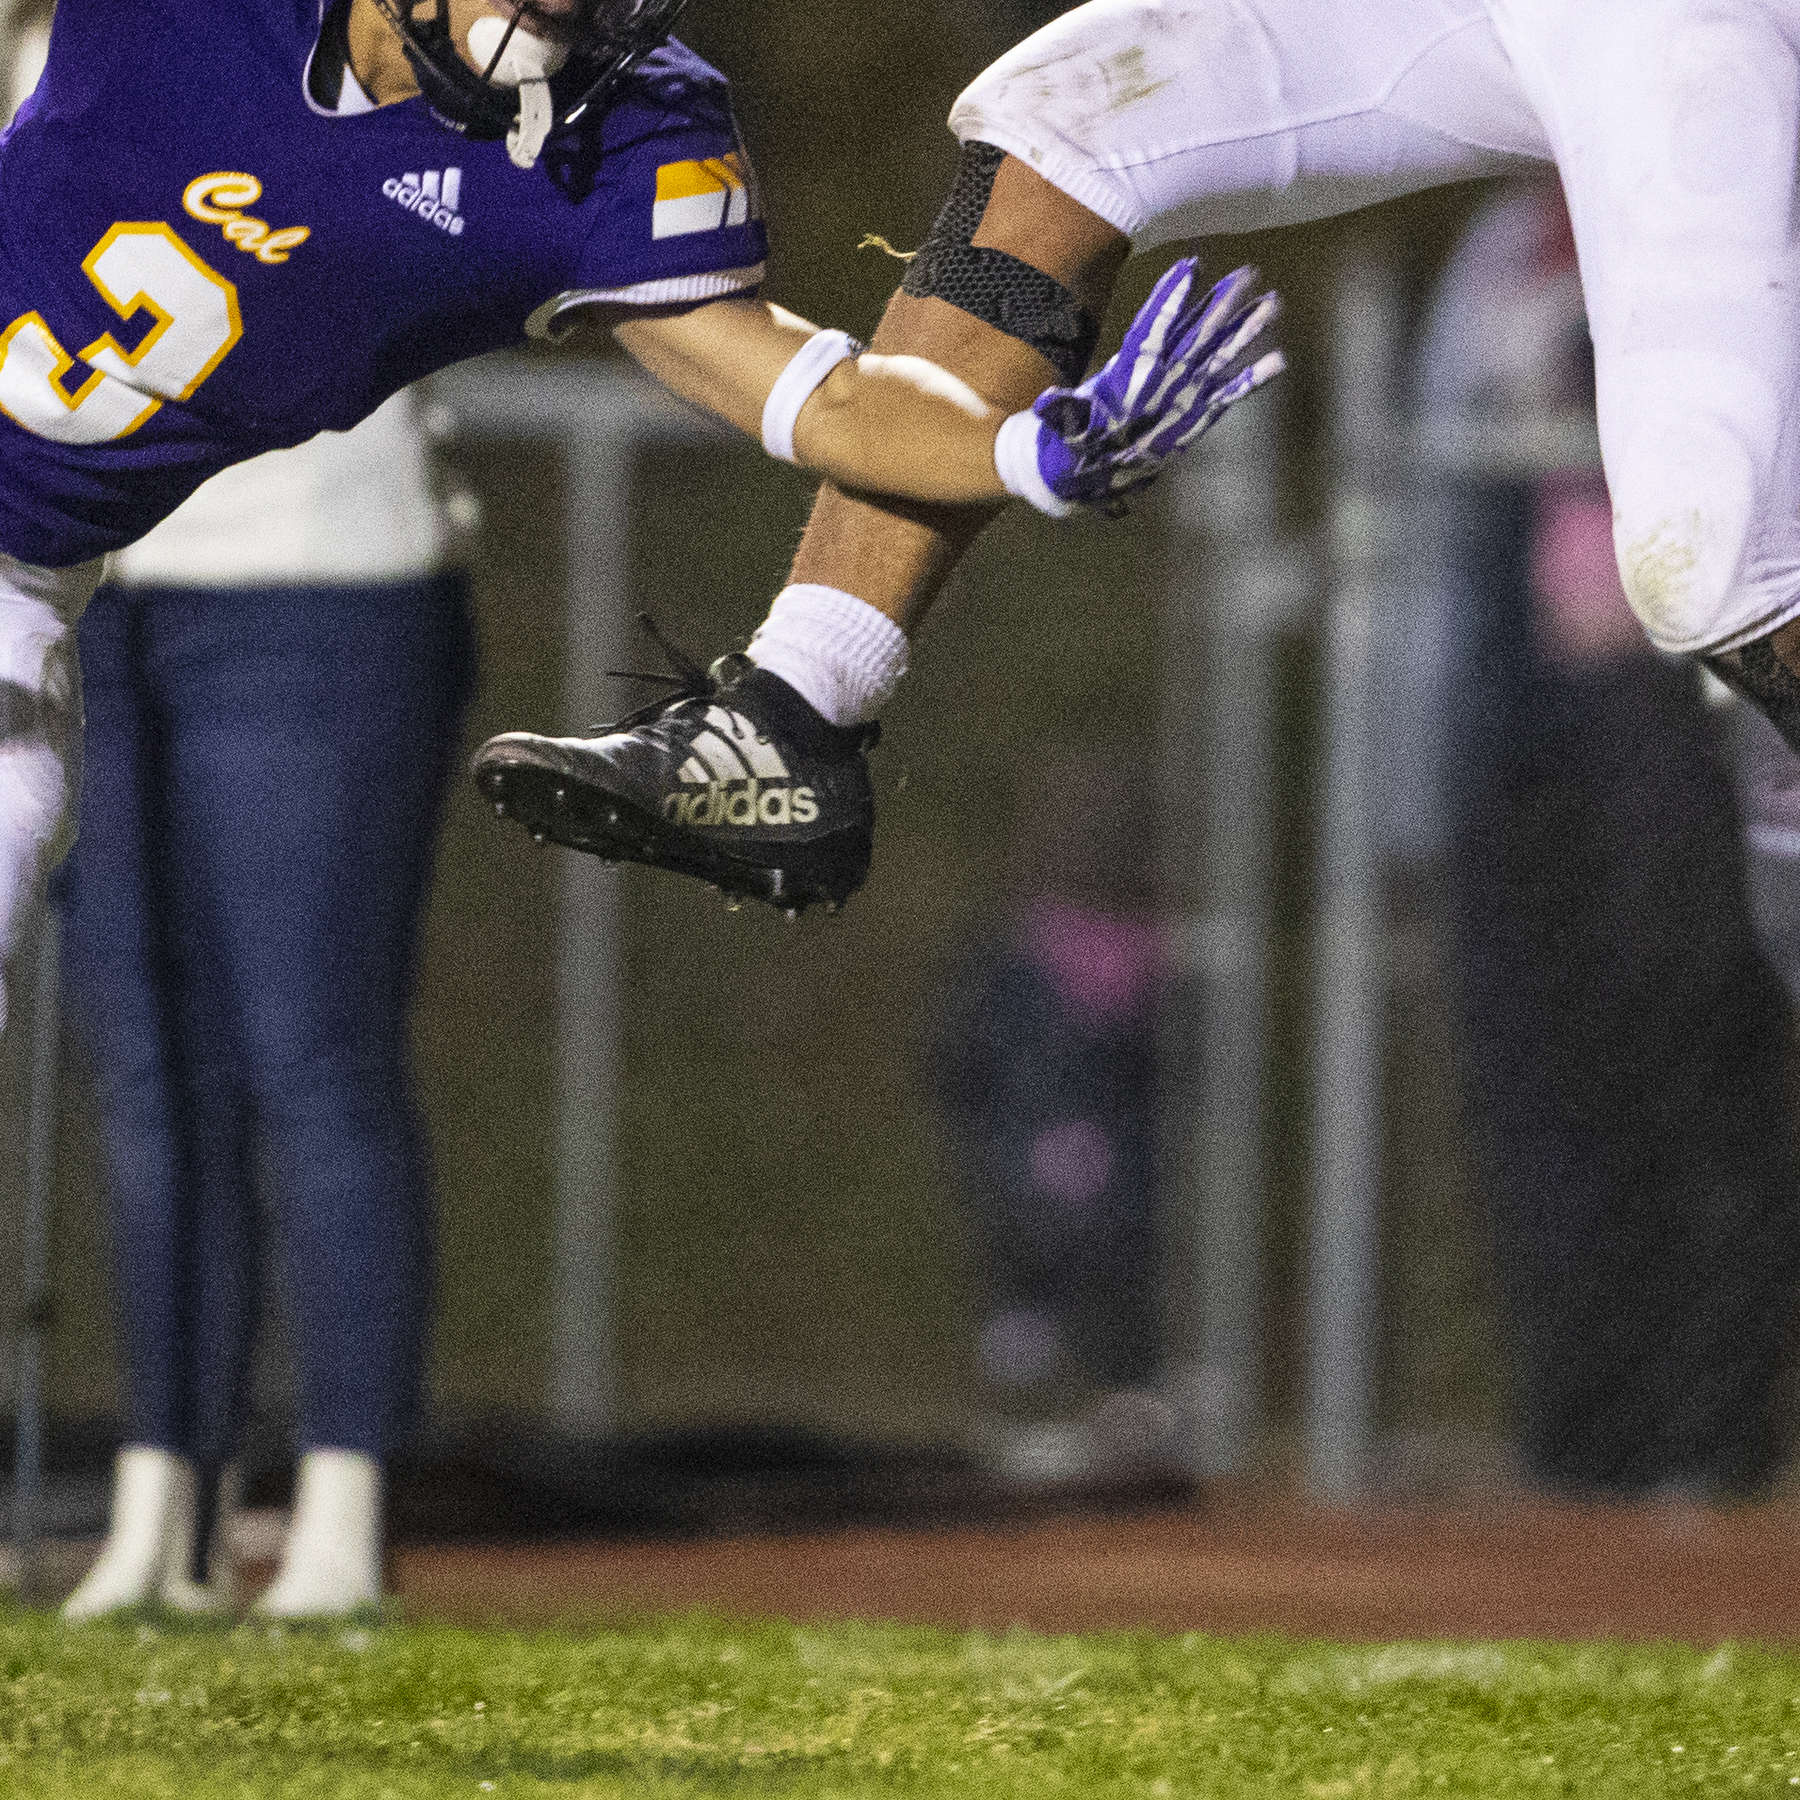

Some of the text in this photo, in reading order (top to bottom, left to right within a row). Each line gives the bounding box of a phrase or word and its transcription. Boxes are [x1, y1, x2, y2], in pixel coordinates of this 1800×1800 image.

[182, 170, 311, 265] Cal
[382, 177, 465, 236] adidas
[663, 779, 820, 826] adidas
